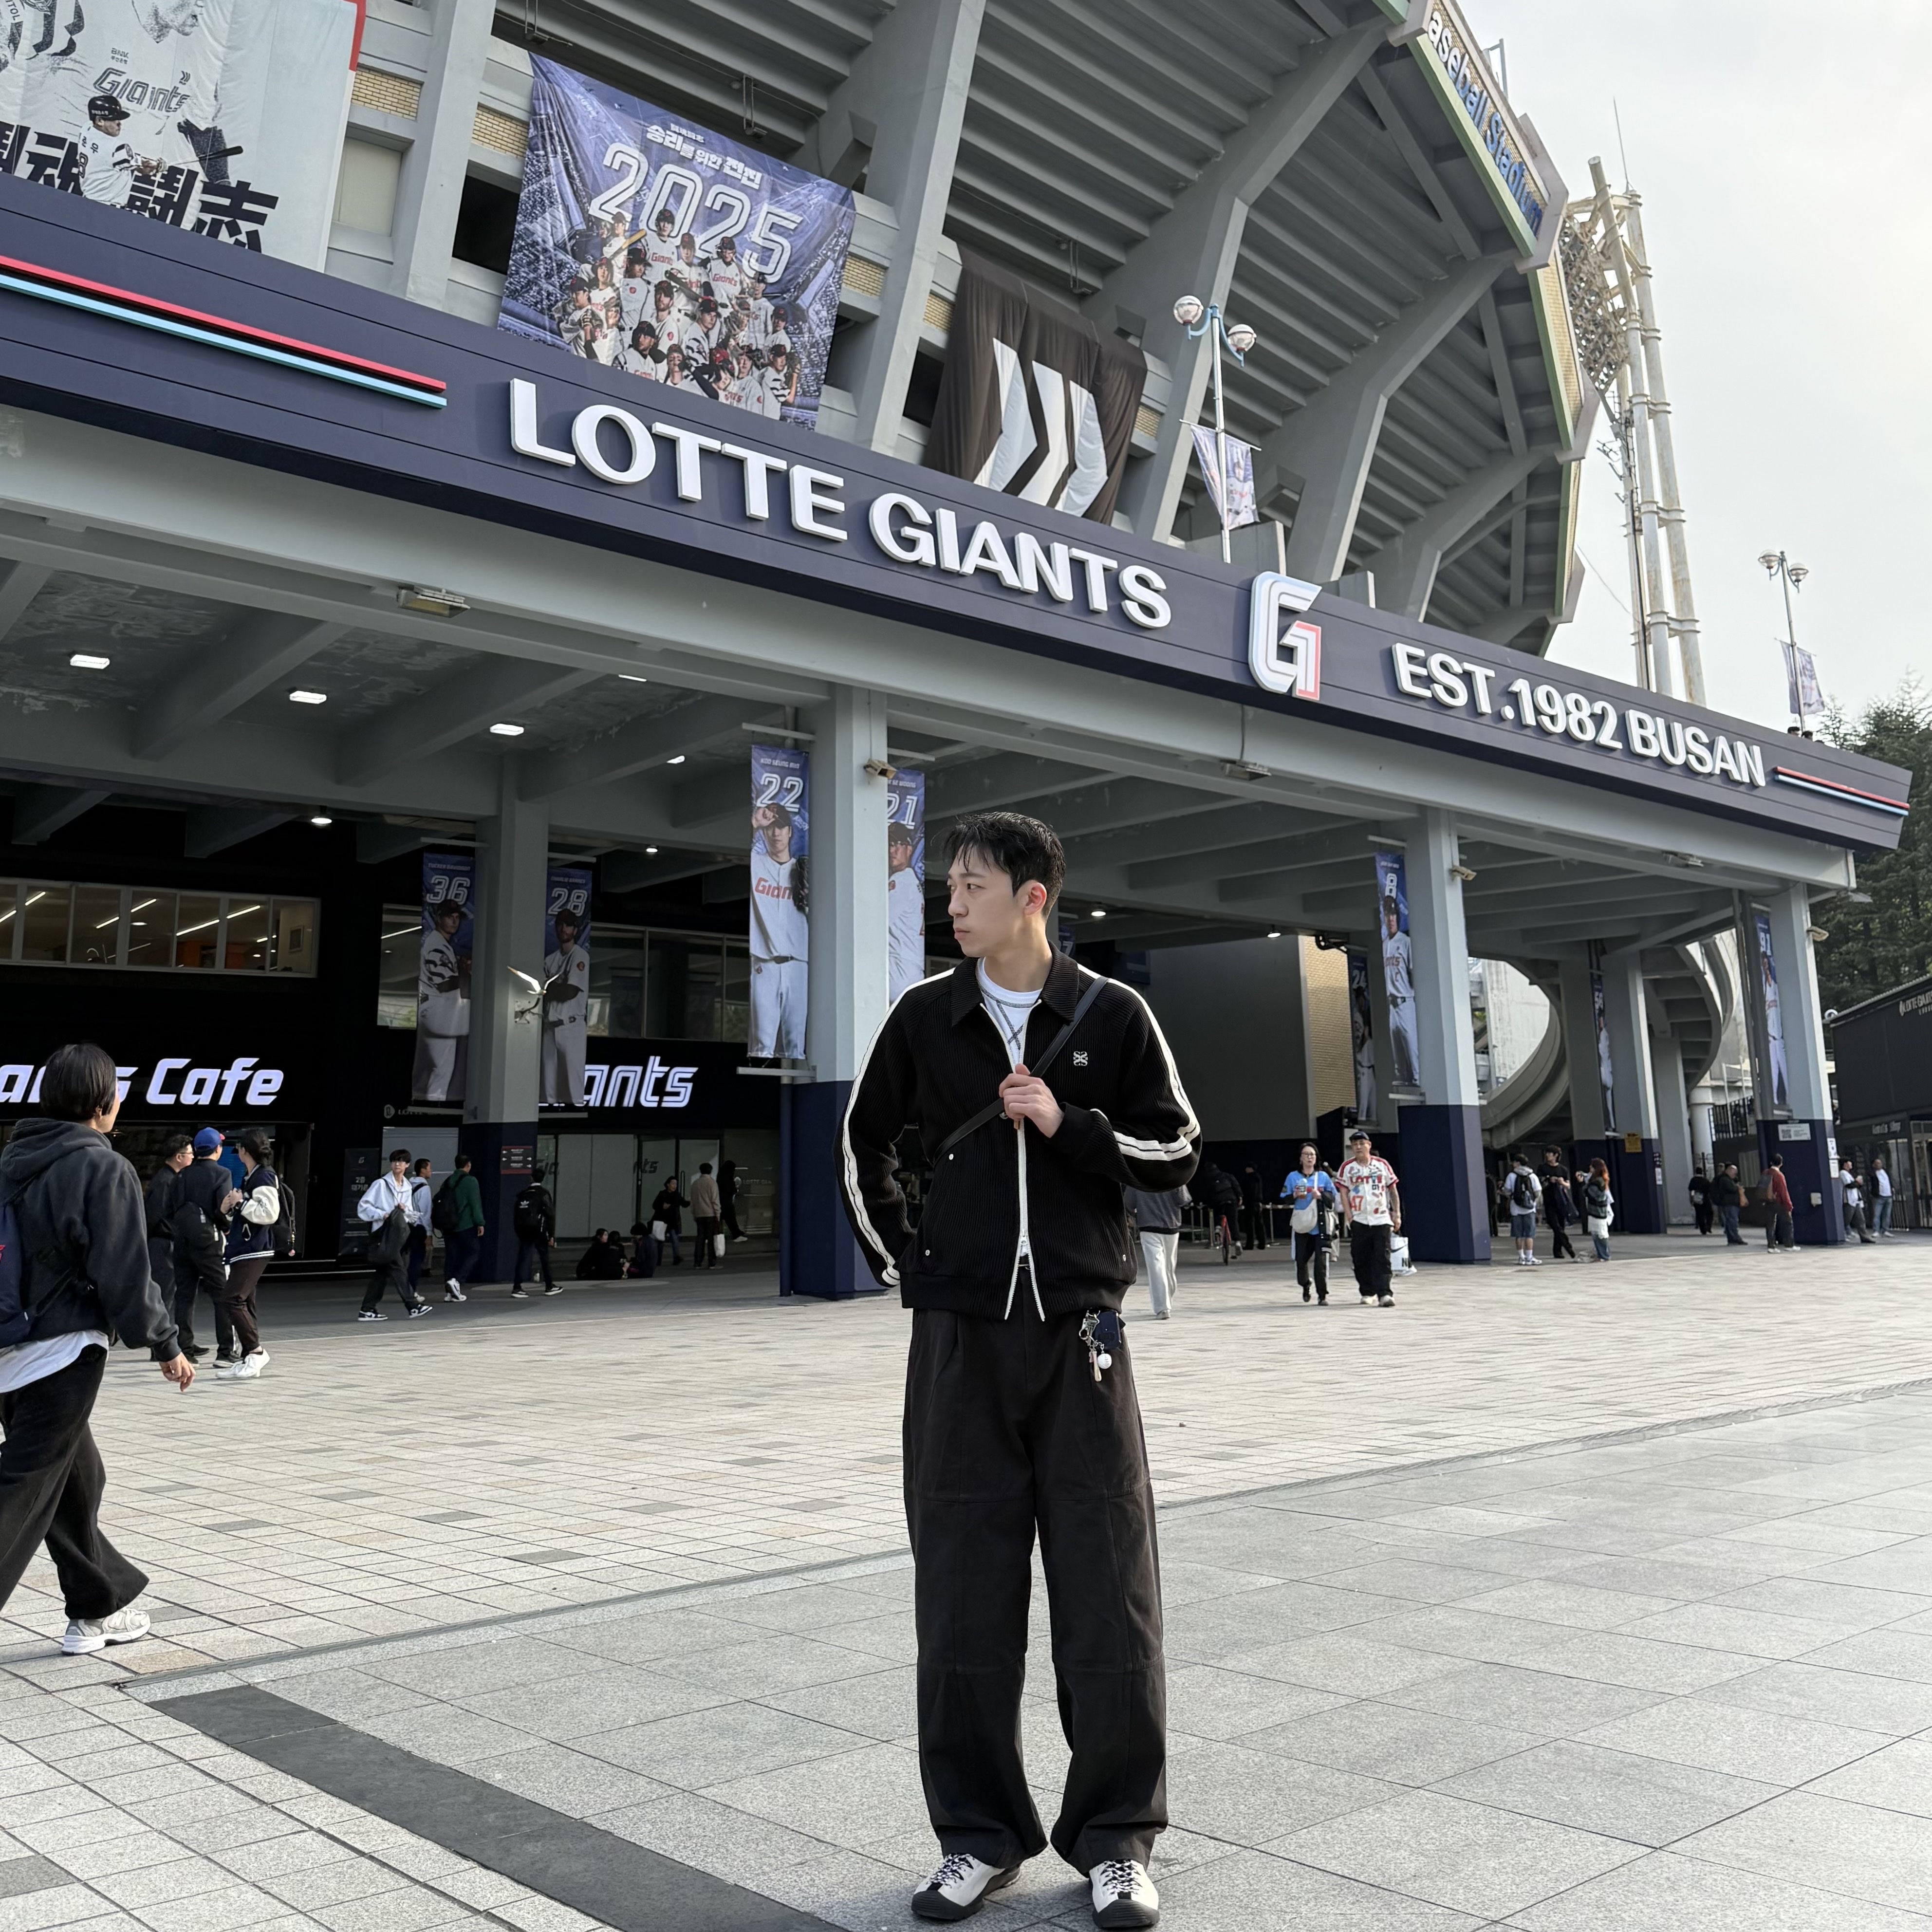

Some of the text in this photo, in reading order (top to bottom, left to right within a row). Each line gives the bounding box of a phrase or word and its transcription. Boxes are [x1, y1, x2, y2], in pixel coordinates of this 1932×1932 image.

[646, 125, 695, 160] 승리를
[694, 149, 723, 170] 위한
[723, 156, 762, 190] 전진
[588, 142, 804, 284] 2025
[712, 273, 738, 287] Giants
[510, 378, 1171, 629] LOTTE GIANTS
[1625, 708, 1766, 787] BUSAN
[756, 772, 803, 812] 22
[887, 793, 918, 829] 21
[426, 875, 471, 905] 36
[548, 887, 588, 916] 28
[754, 877, 792, 900] Gian
[1385, 873, 1397, 899] 8
[147, 1058, 284, 1105] Cafe
[583, 1056, 698, 1108] ants
